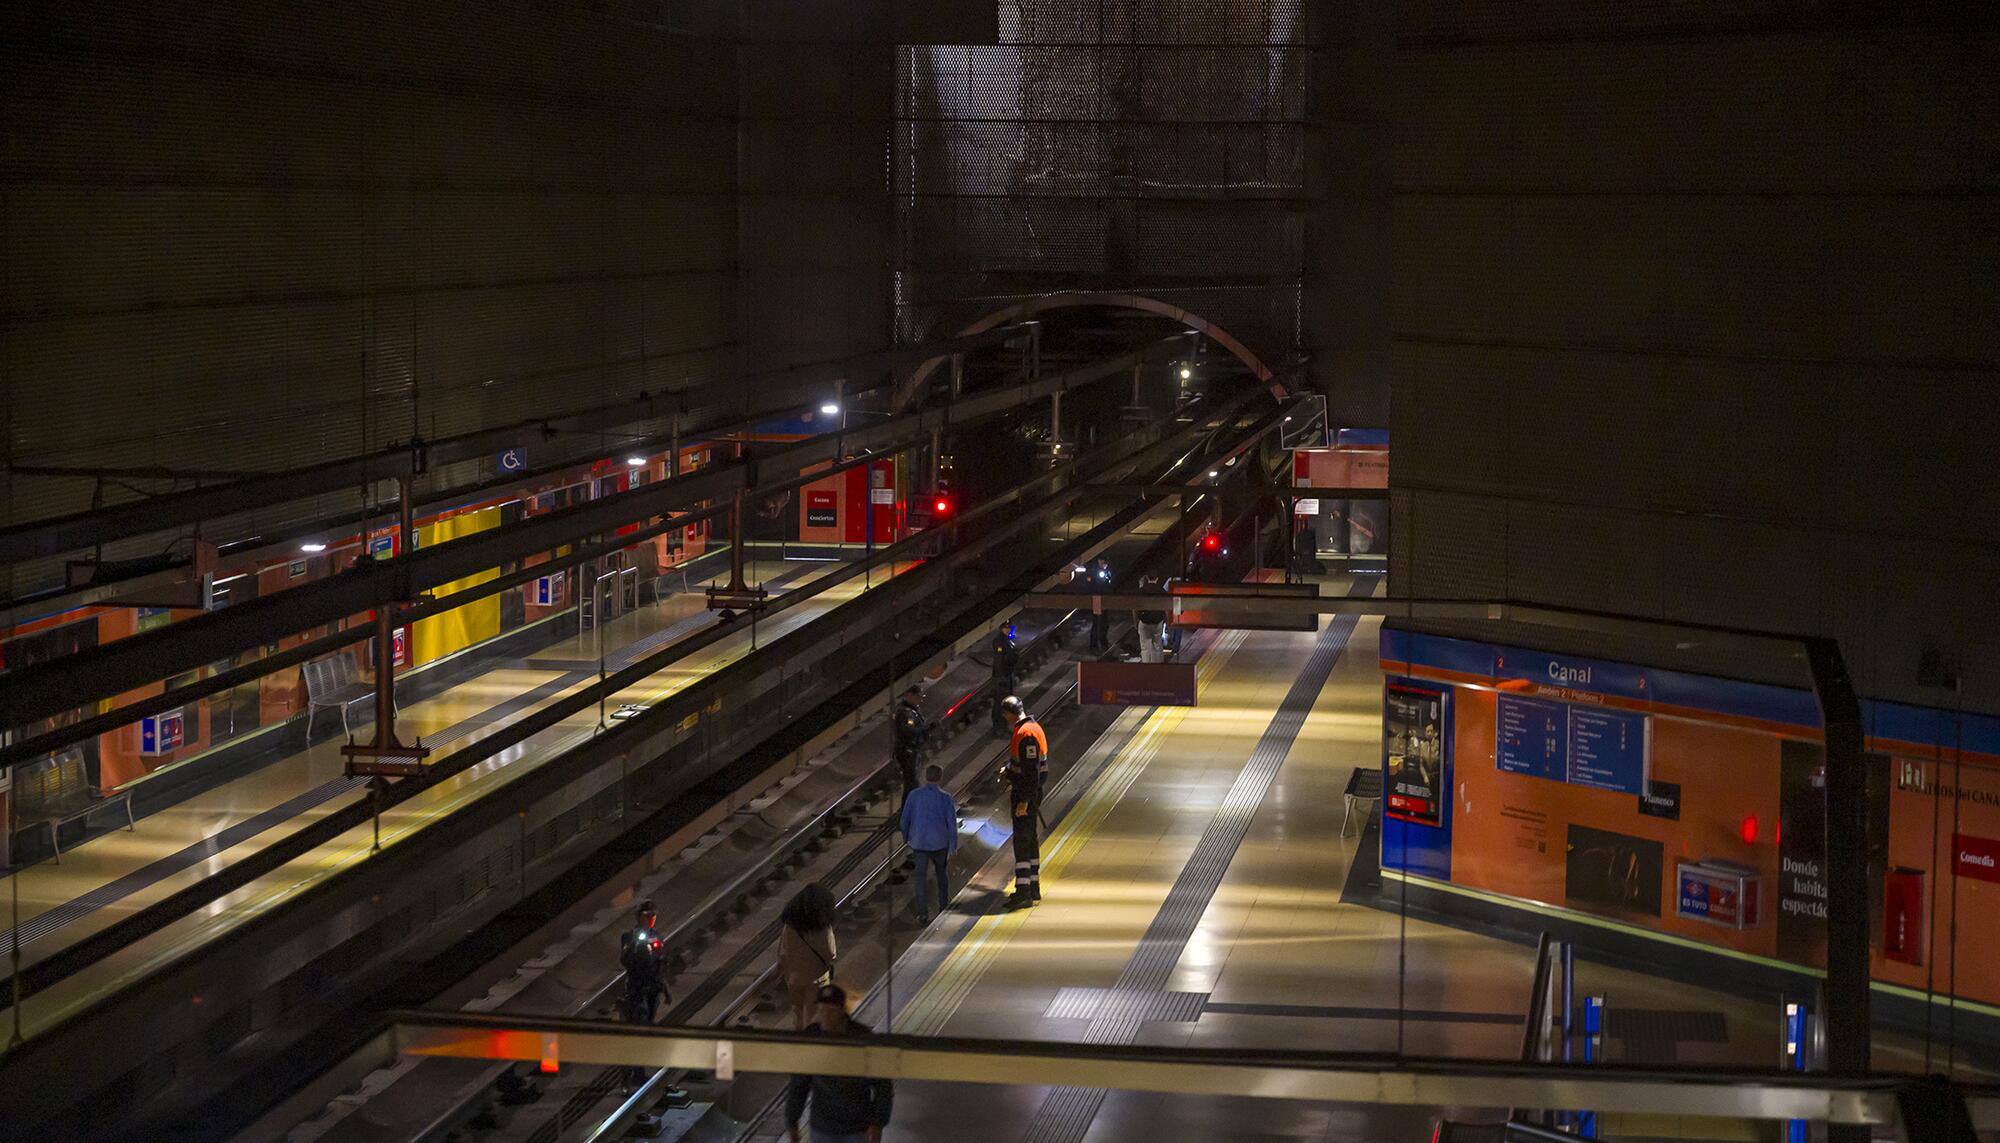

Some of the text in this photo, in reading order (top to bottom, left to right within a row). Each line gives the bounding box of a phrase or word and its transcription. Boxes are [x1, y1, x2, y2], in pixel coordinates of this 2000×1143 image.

[1548, 661, 1592, 684] Canal
[1784, 857, 1818, 877] Donde
[1960, 851, 1995, 868] Comedia
[1793, 877, 1828, 898] habita
